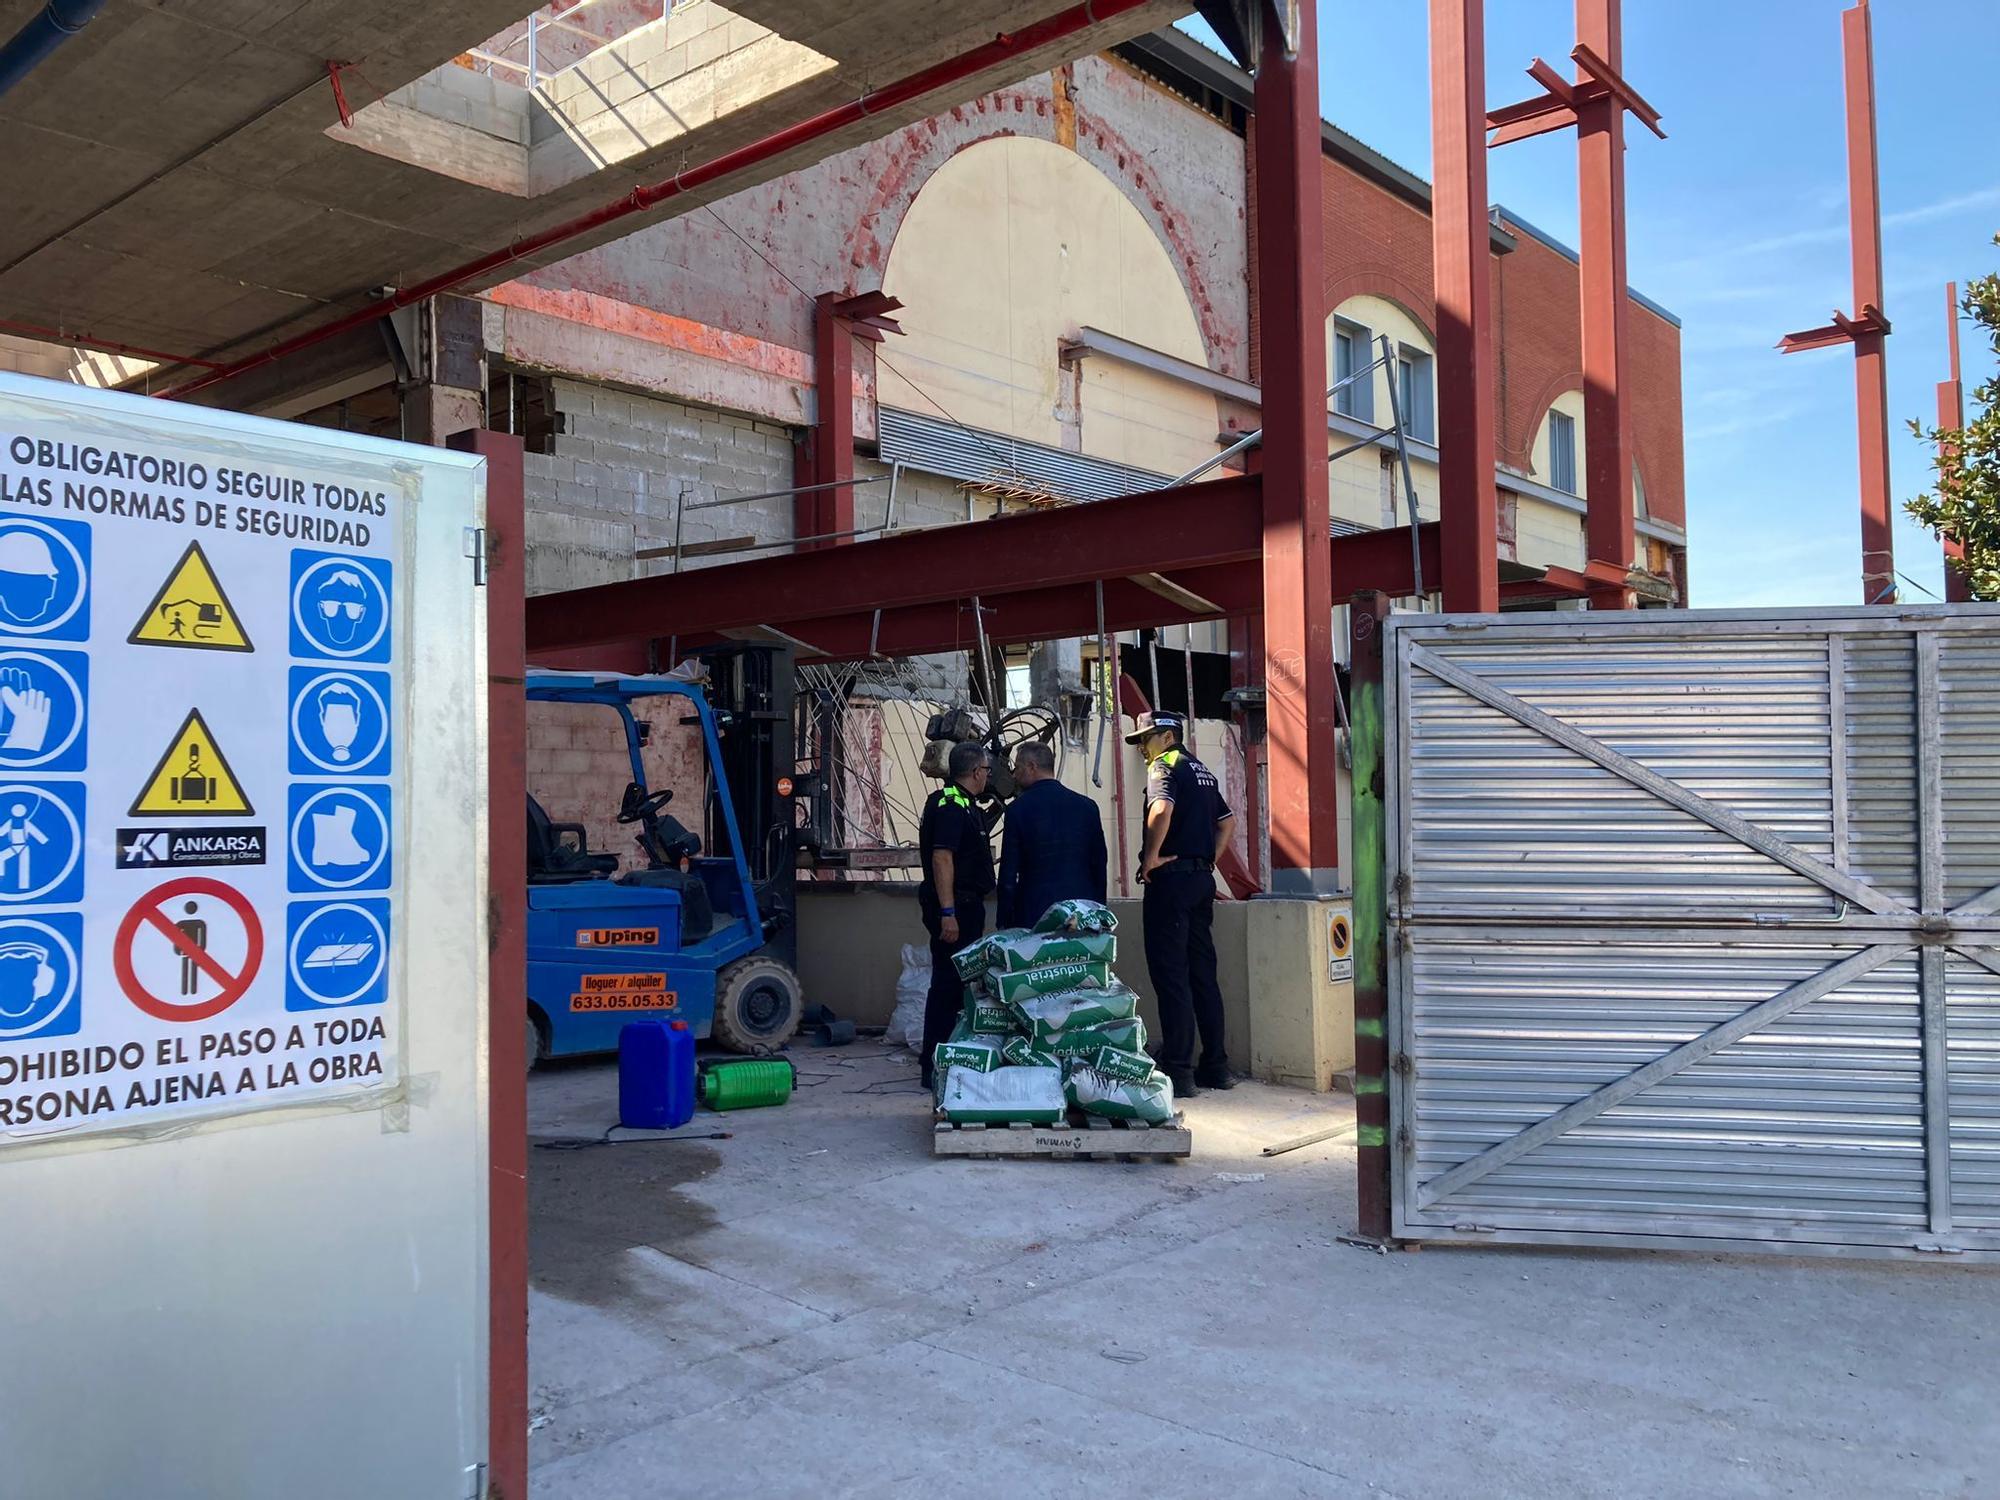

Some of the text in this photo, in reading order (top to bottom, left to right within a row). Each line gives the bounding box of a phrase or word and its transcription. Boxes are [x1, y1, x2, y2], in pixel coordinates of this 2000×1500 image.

[10, 436, 386, 517] OBLIGATORIO SEGUIR TODAS
[0, 473, 371, 547] LAS NORMAS DE SEGURIDAD
[173, 836, 261, 852] ANKARSA
[593, 930, 656, 945] Uping
[586, 976, 617, 991] lloguer
[628, 975, 662, 989] alquiler
[1026, 963, 1087, 985] industrial
[573, 994, 674, 1009] 633.05.05.33
[0, 1016, 386, 1085] OHIBIDO EL PASO A TODA
[0, 1051, 382, 1125] RSONA AJENA A LA OBRA
